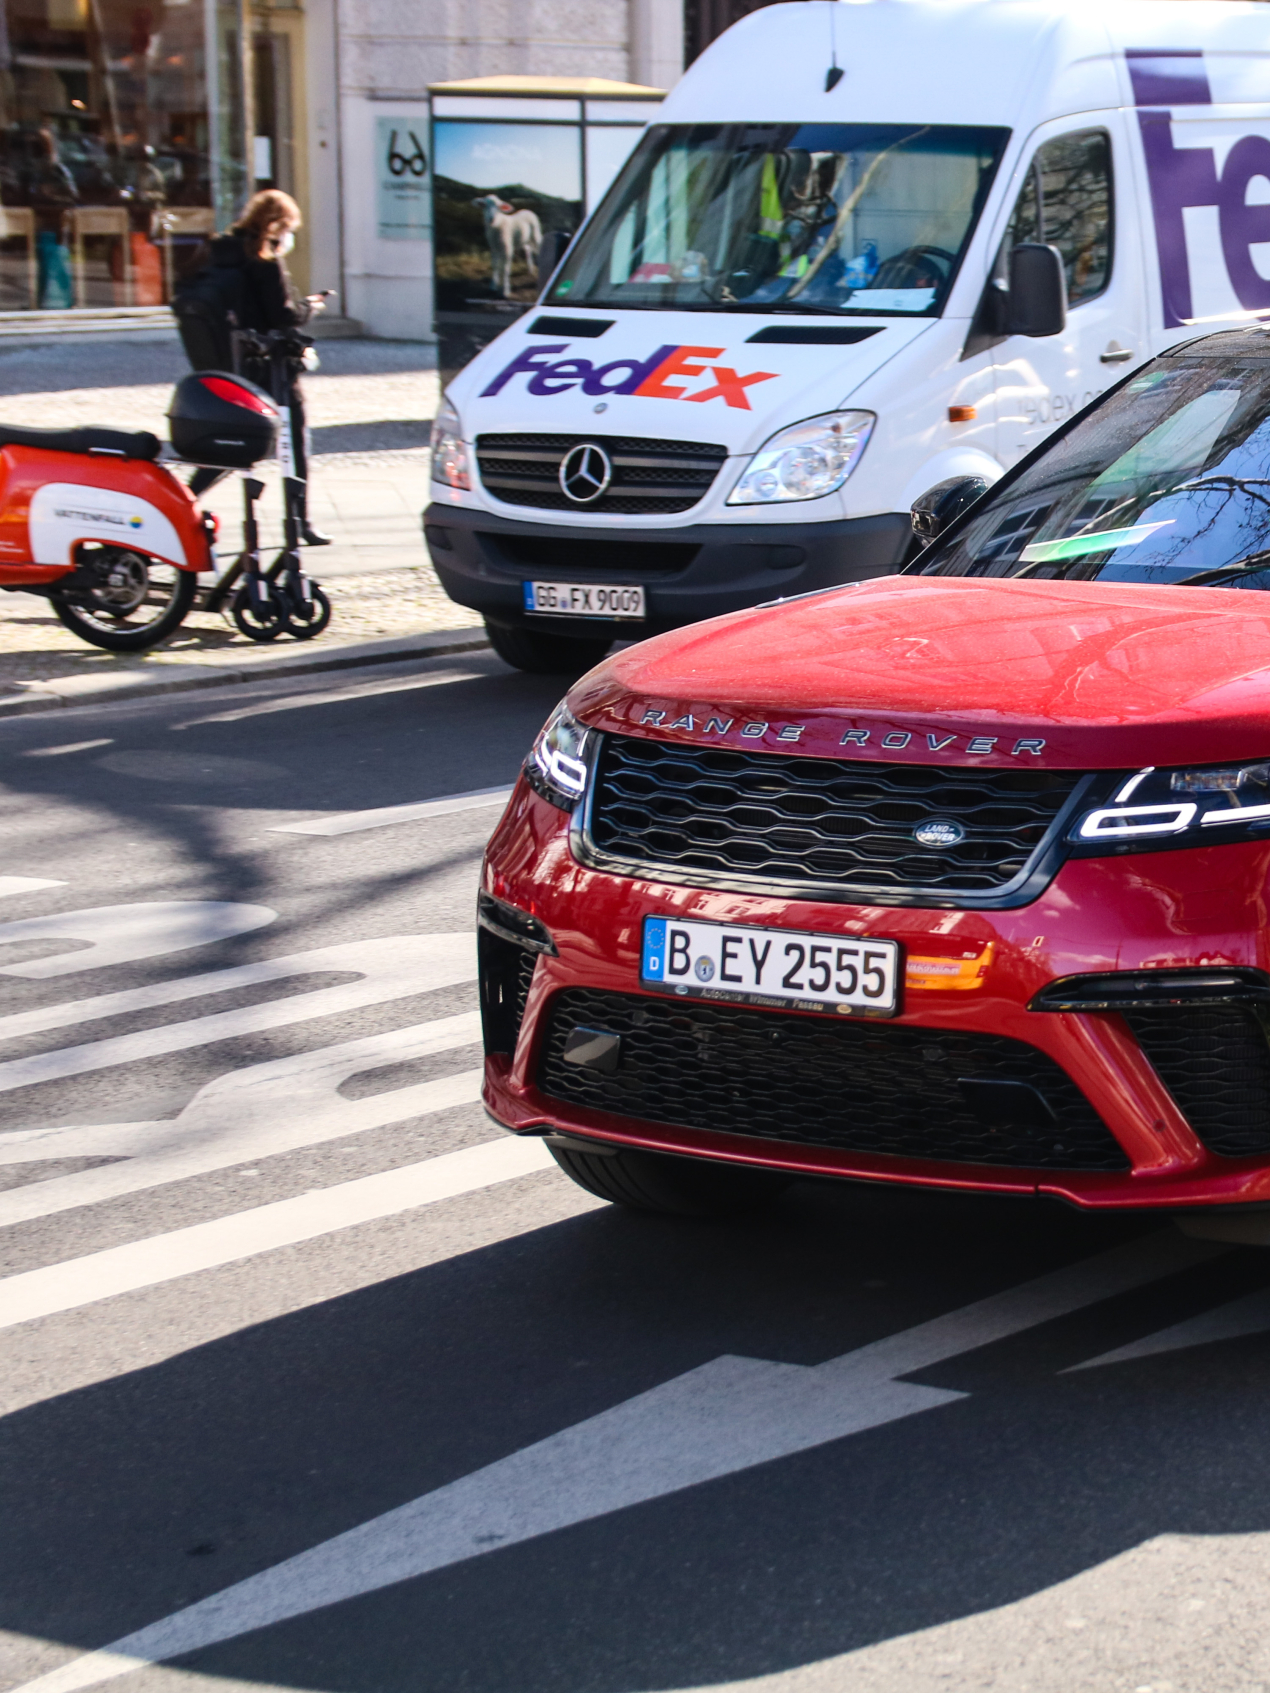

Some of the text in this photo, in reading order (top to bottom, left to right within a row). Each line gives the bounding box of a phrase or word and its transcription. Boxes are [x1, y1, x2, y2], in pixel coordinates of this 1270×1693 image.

[478, 343, 782, 411] FedEx
[537, 586, 640, 612] GG FX 9009
[639, 709, 1047, 756] RANGE ROVER
[924, 832, 956, 841] ROVER
[649, 956, 660, 971] D
[668, 929, 888, 998] B EY 2555
